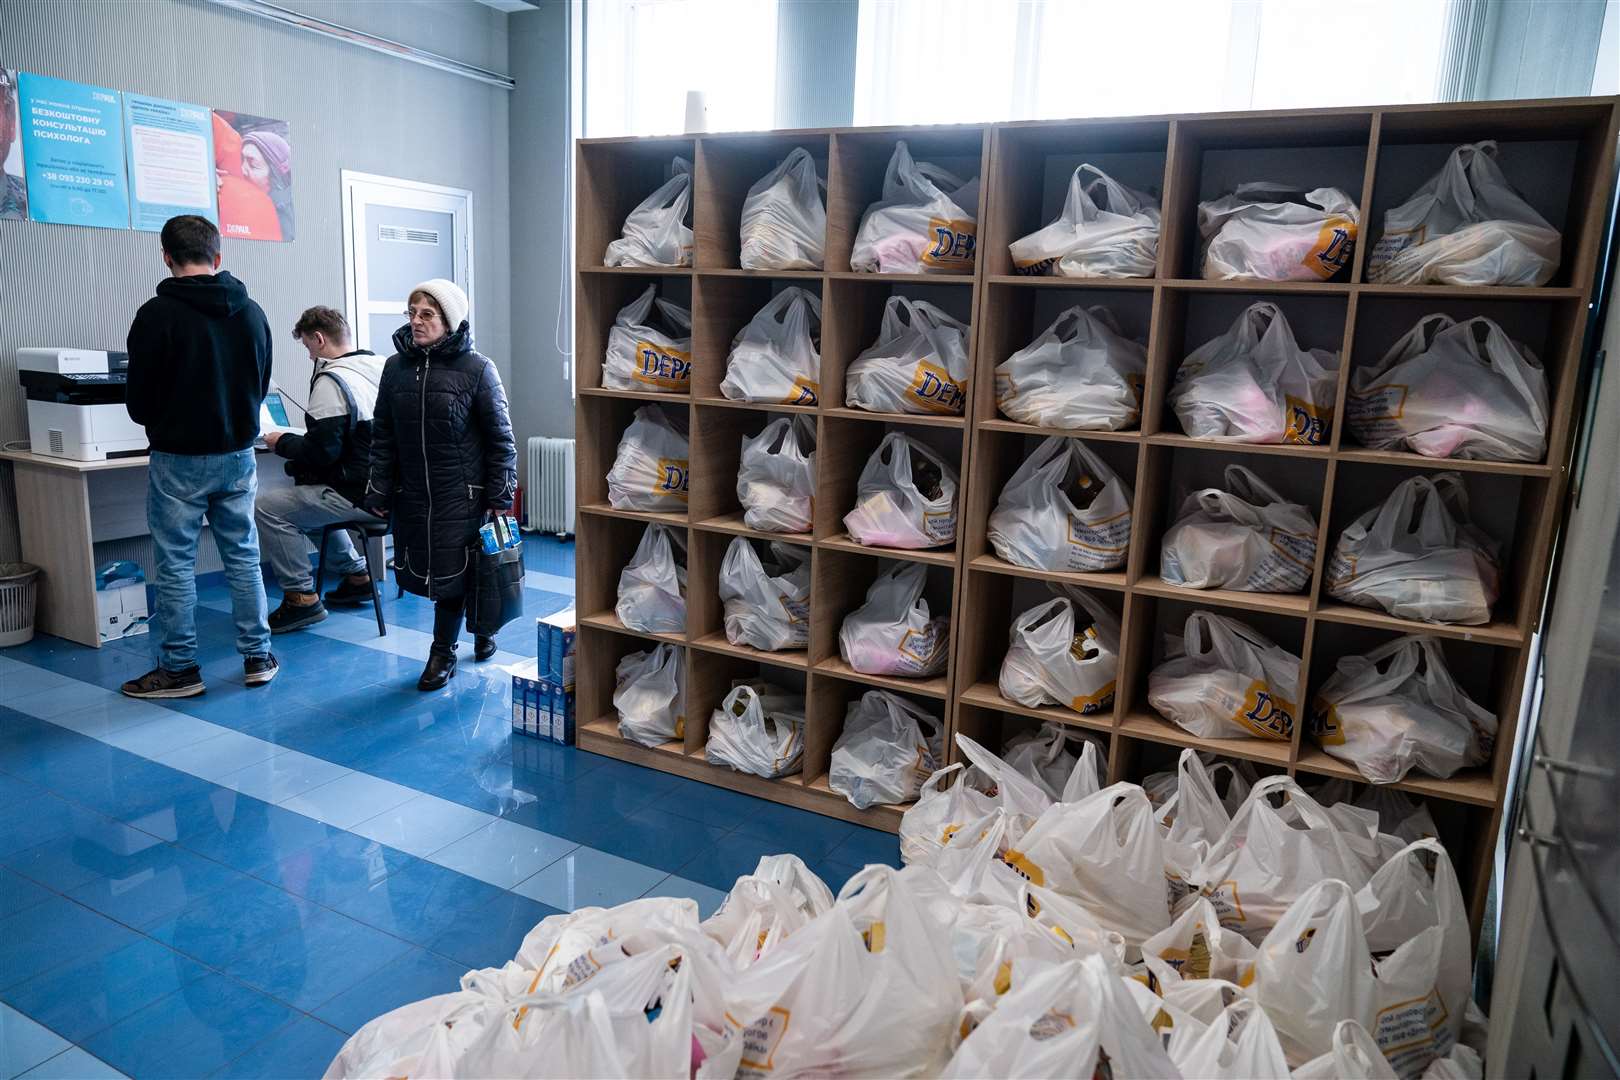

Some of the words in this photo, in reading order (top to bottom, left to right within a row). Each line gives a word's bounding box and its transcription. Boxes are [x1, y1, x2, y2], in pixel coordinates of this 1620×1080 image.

[31, 107, 101, 125] БЕЗКОШТОВНУ
[32, 118, 107, 137] КОНСУЛЬТАЦІЮ
[33, 129, 92, 145] ПСИХОЛОГА
